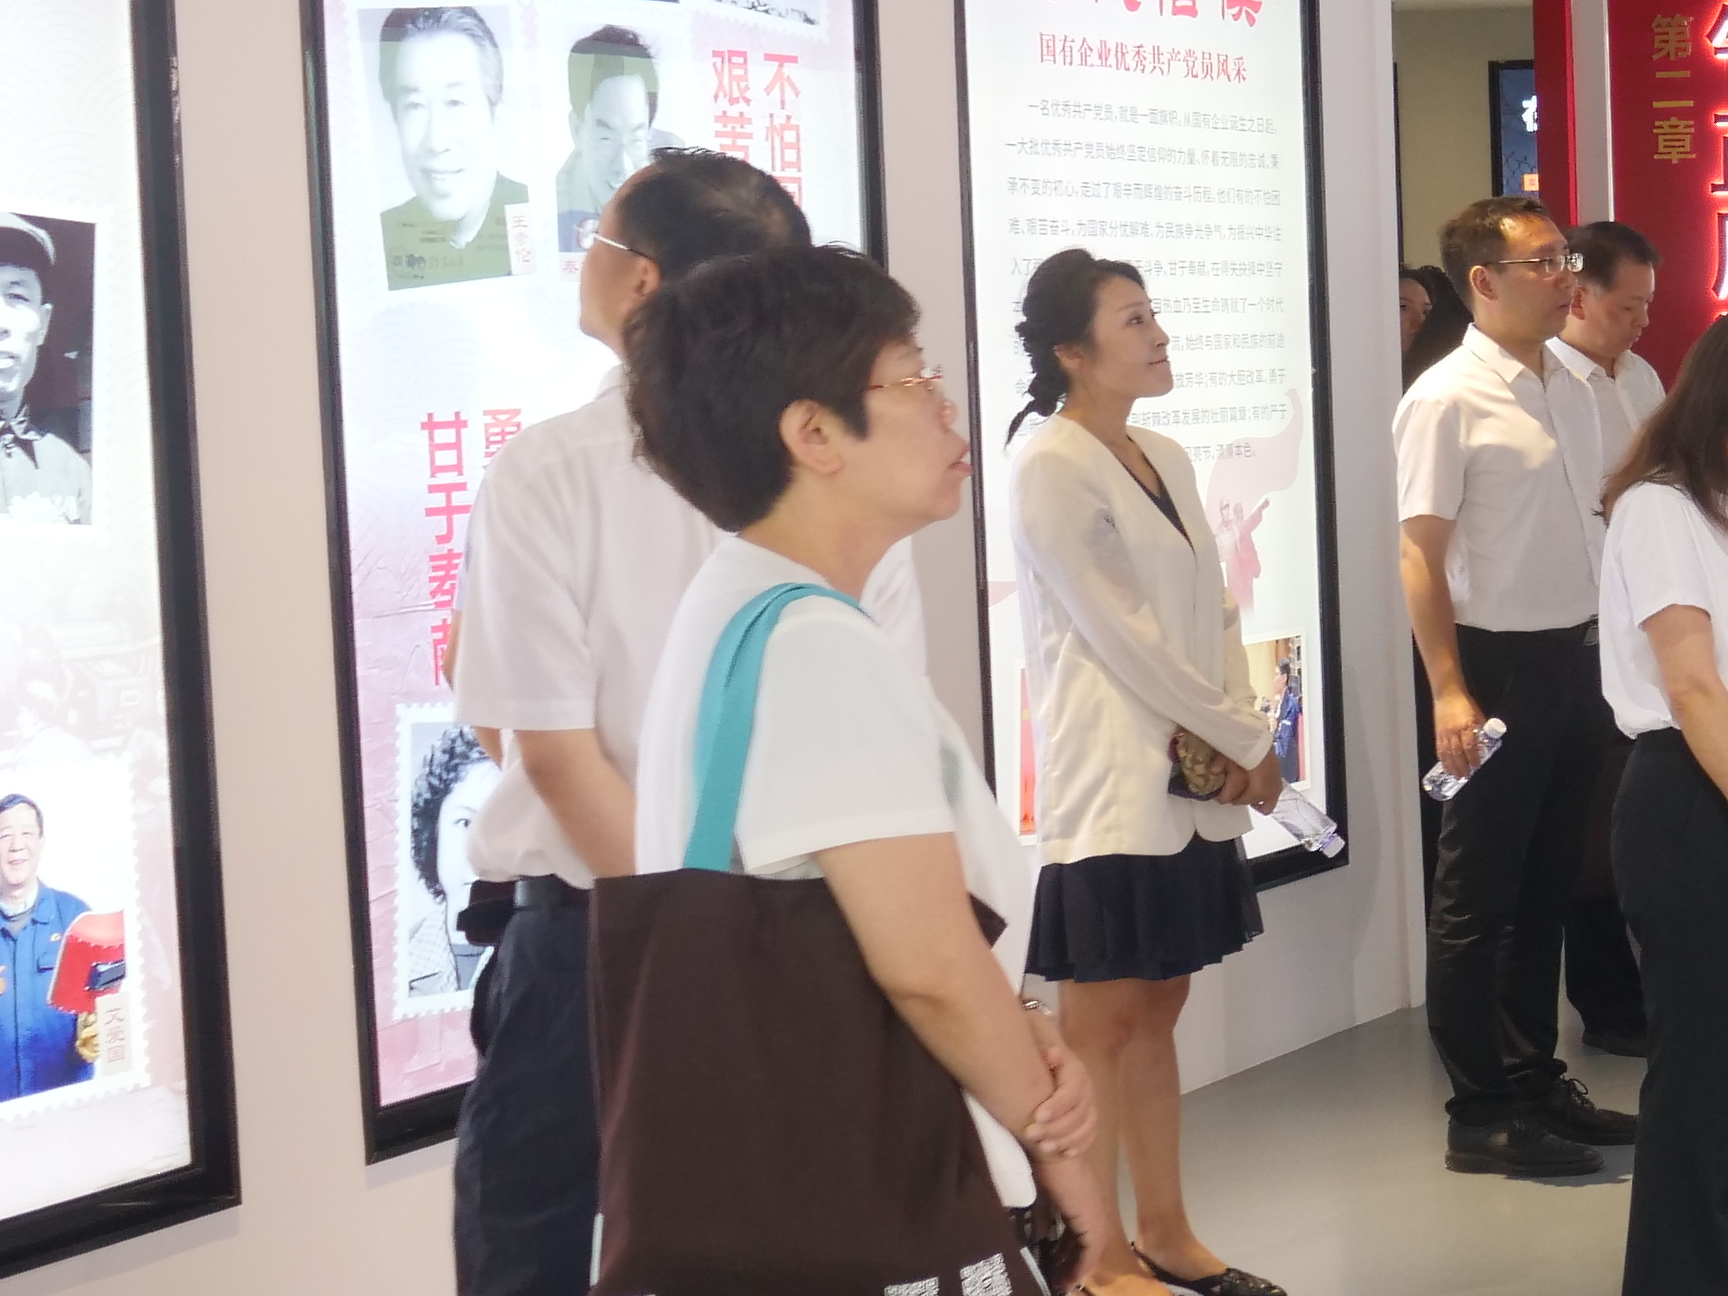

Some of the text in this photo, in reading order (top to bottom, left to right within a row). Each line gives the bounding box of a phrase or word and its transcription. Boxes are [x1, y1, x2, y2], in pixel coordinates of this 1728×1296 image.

[1039, 31, 1247, 84] 国有企业优秀共产党员风采
[1652, 13, 1696, 164] 第二章
